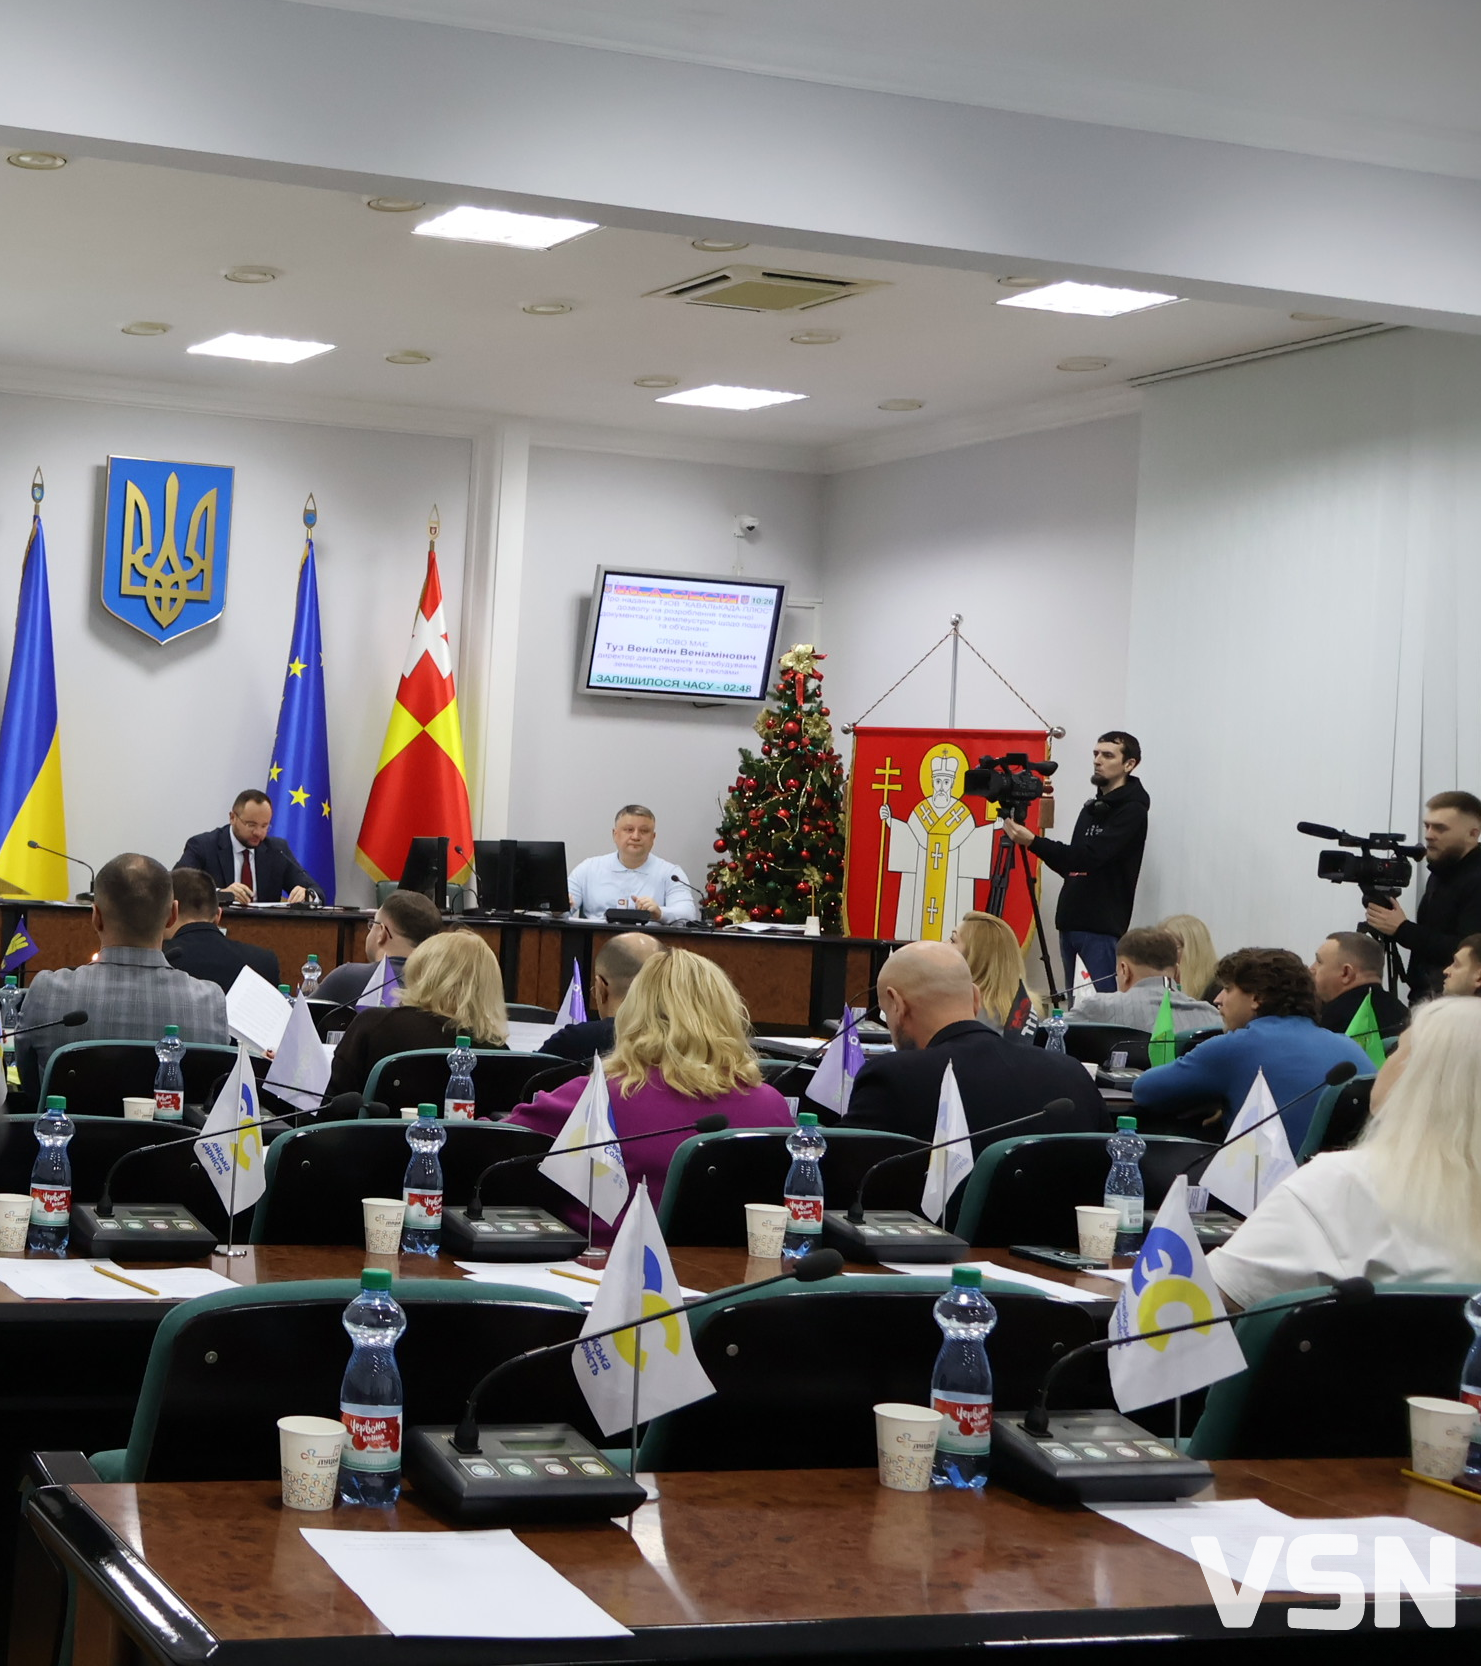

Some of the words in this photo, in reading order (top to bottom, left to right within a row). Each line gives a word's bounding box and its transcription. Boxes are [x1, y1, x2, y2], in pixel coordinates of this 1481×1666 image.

[751, 597, 773, 605] 10:26
[604, 642, 623, 651] Туз
[627, 644, 676, 654] Веніамін
[679, 648, 756, 660] Веніамінович
[595, 674, 679, 687] ЗАЛИШИЛОСЯ
[682, 680, 713, 690] ЧАСУ
[722, 684, 751, 692] 02:48
[210, 1142, 230, 1172] ейська
